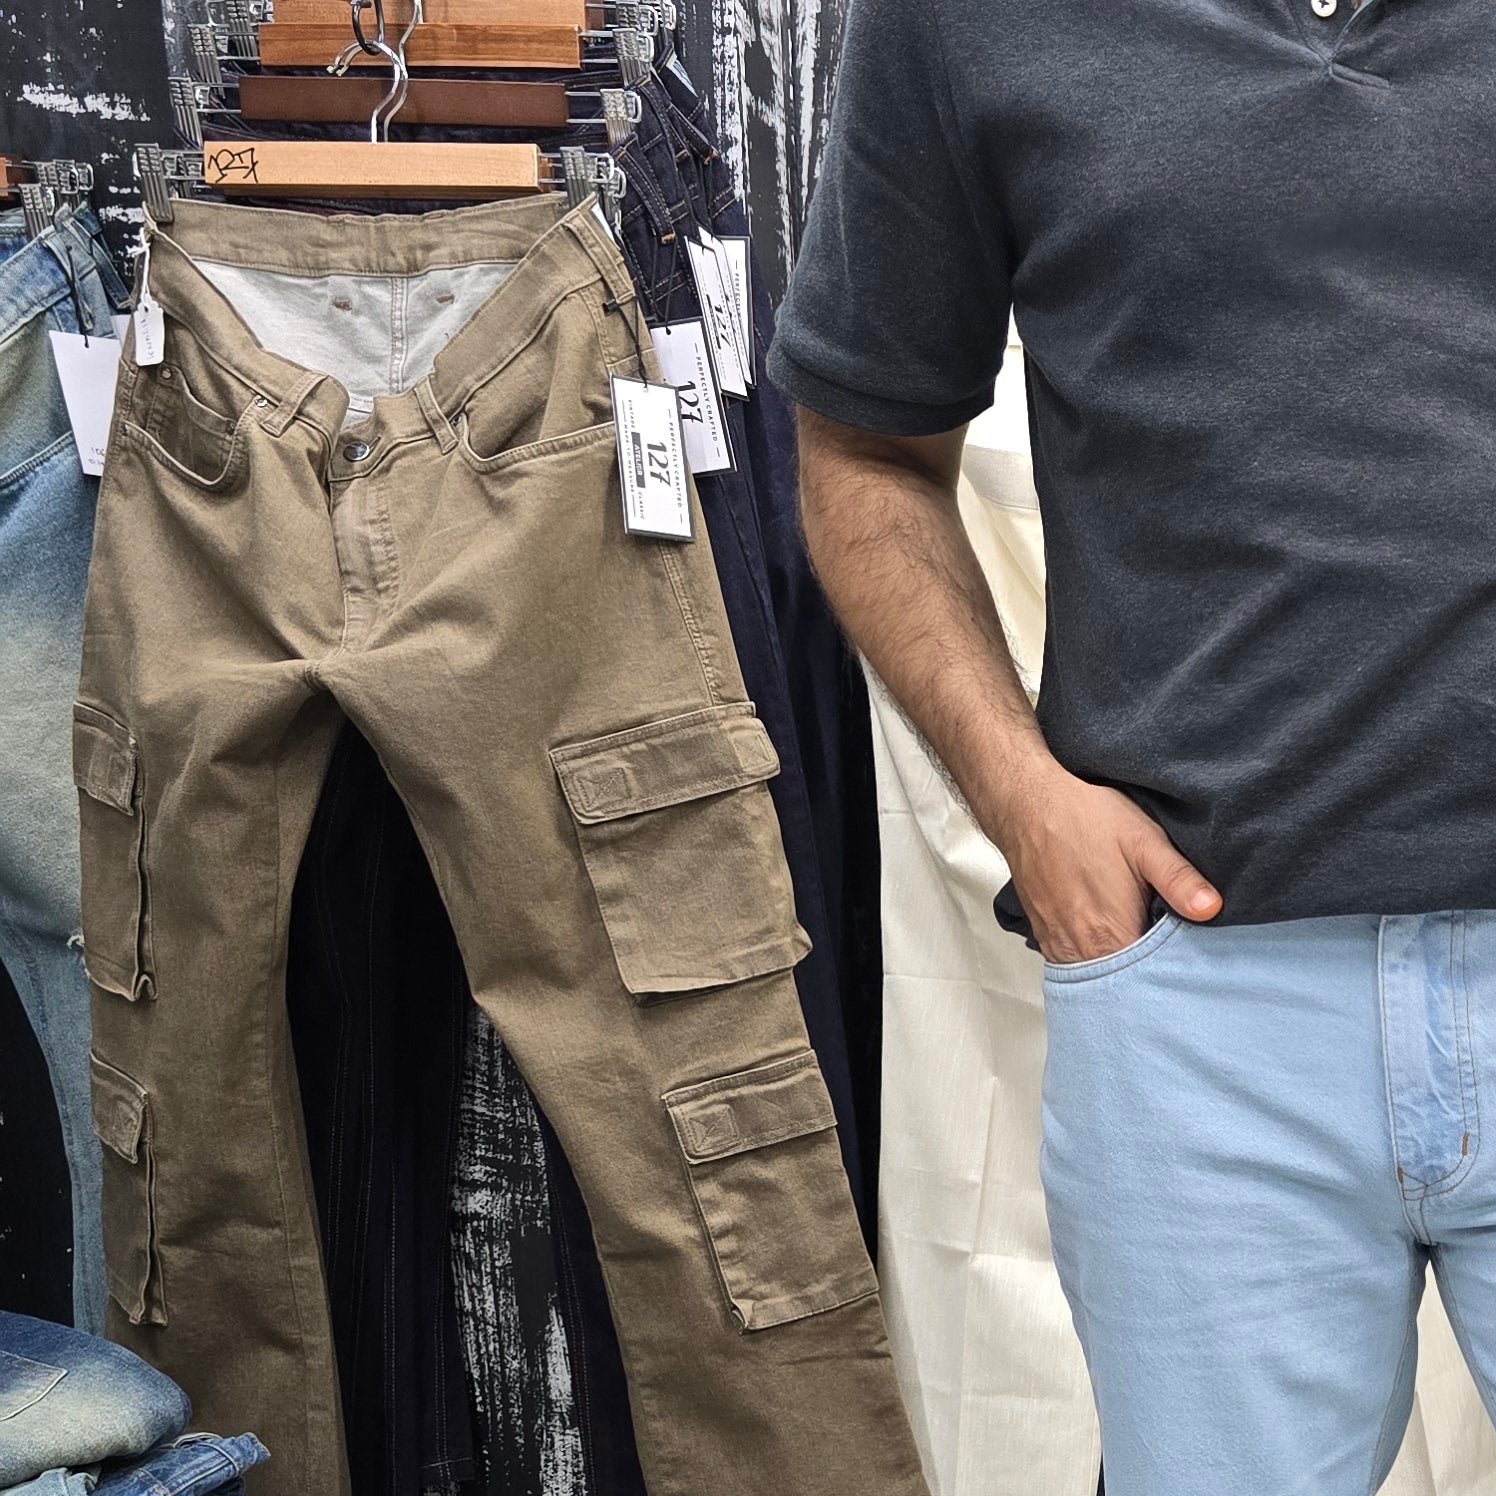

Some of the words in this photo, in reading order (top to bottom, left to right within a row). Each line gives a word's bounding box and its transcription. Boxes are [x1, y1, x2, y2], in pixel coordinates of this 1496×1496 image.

[714, 304, 731, 347] 127
[679, 380, 704, 424] 127
[697, 356, 711, 403] PERFECTLY
[706, 405, 718, 442] CRAFTED
[647, 441, 671, 487] 127
[669, 422, 679, 468] PERFECTLY
[674, 470, 683, 508] CRAFTED
